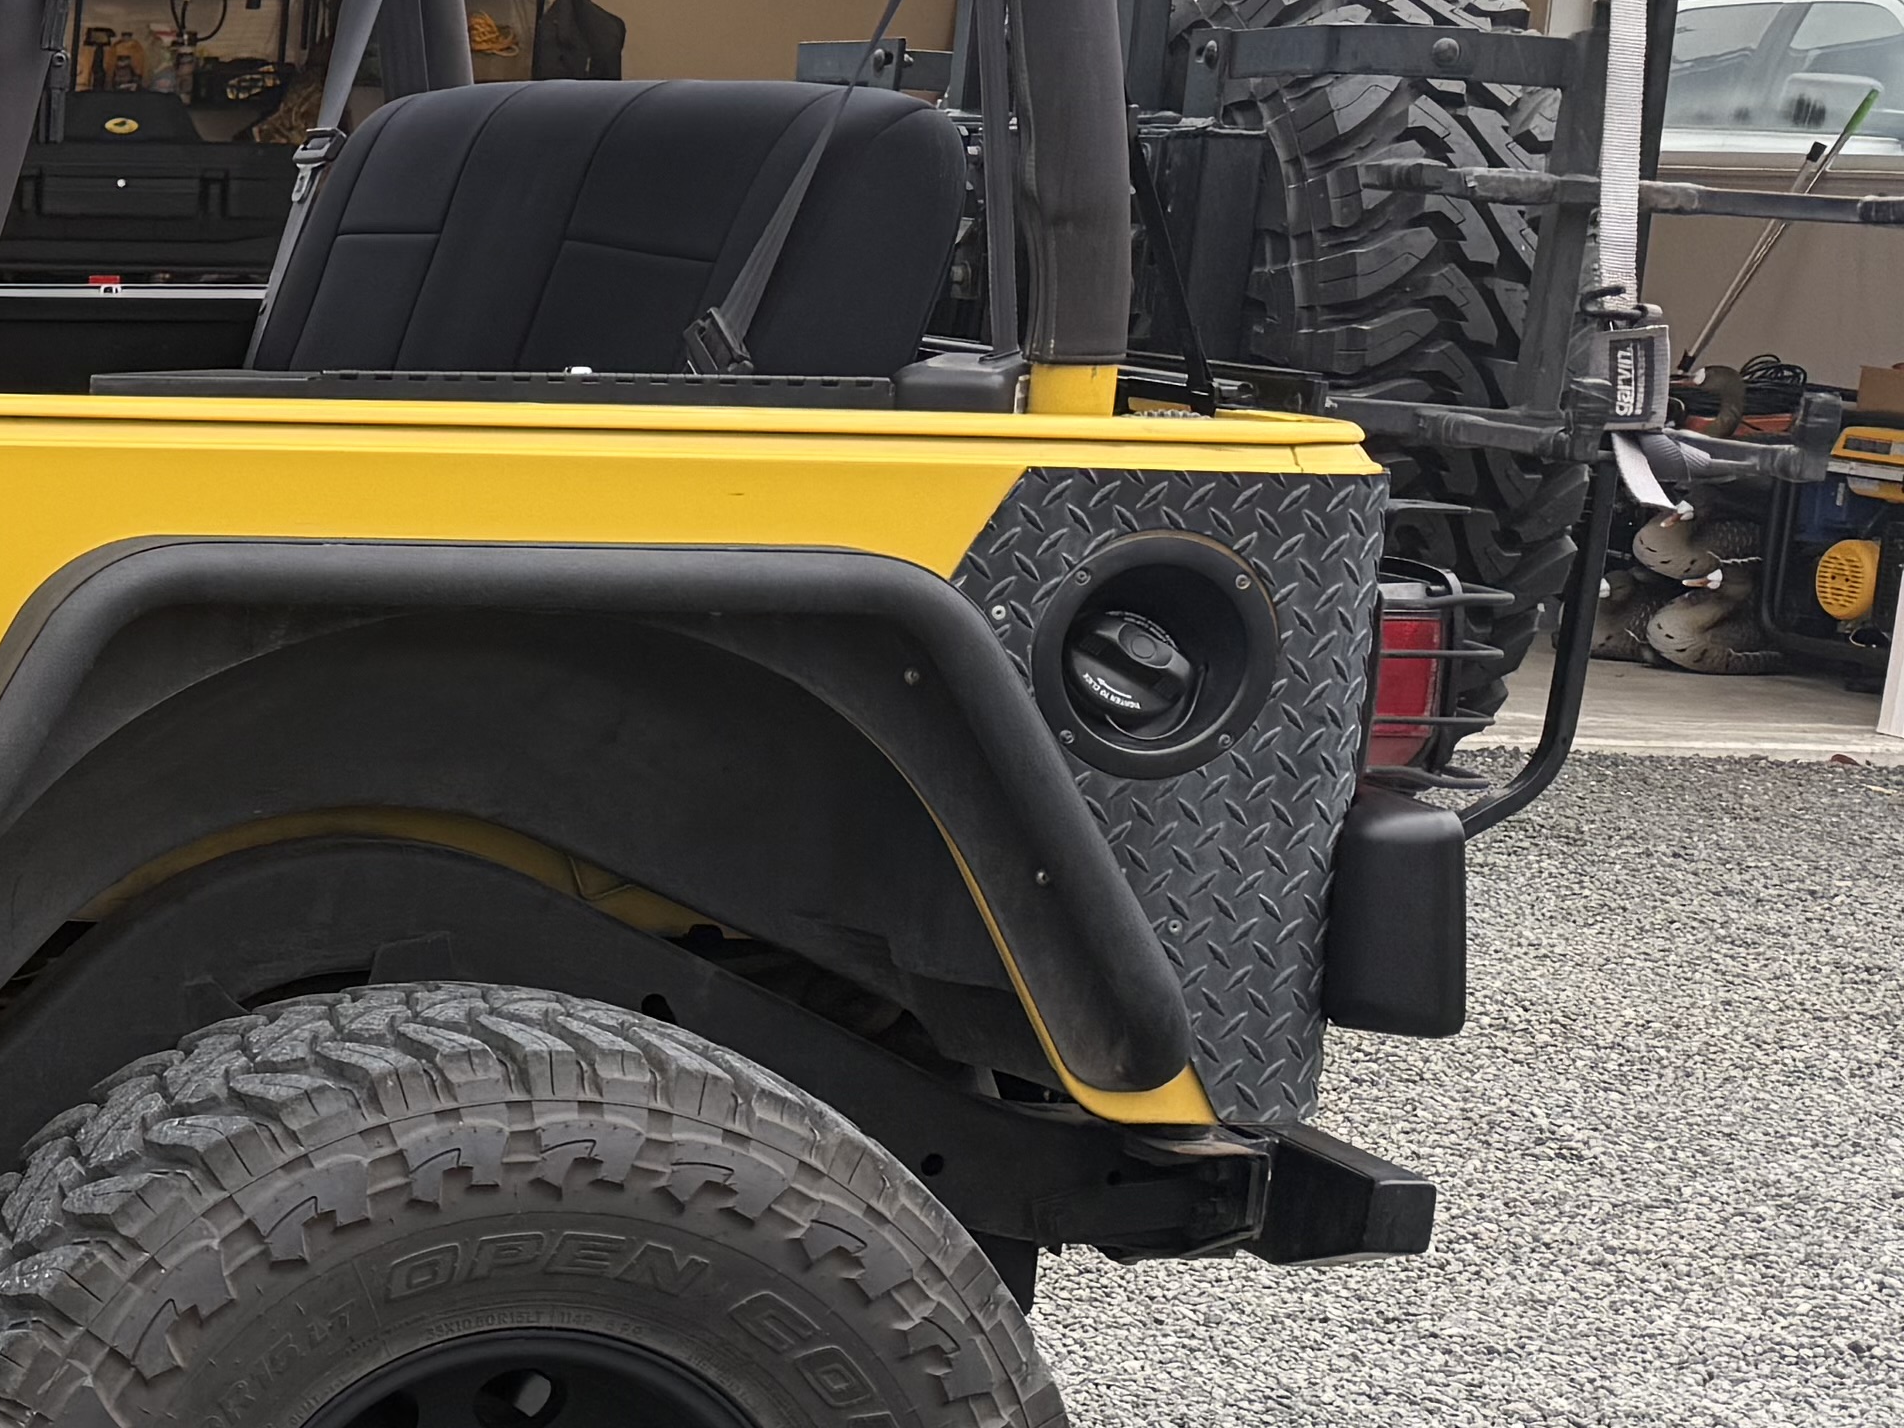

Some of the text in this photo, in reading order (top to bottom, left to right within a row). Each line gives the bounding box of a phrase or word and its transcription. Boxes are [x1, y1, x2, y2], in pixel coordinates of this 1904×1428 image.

[1615, 348, 1634, 416] garvin
[1099, 689, 1110, 700] TO
[388, 1231, 710, 1301] OPEN
